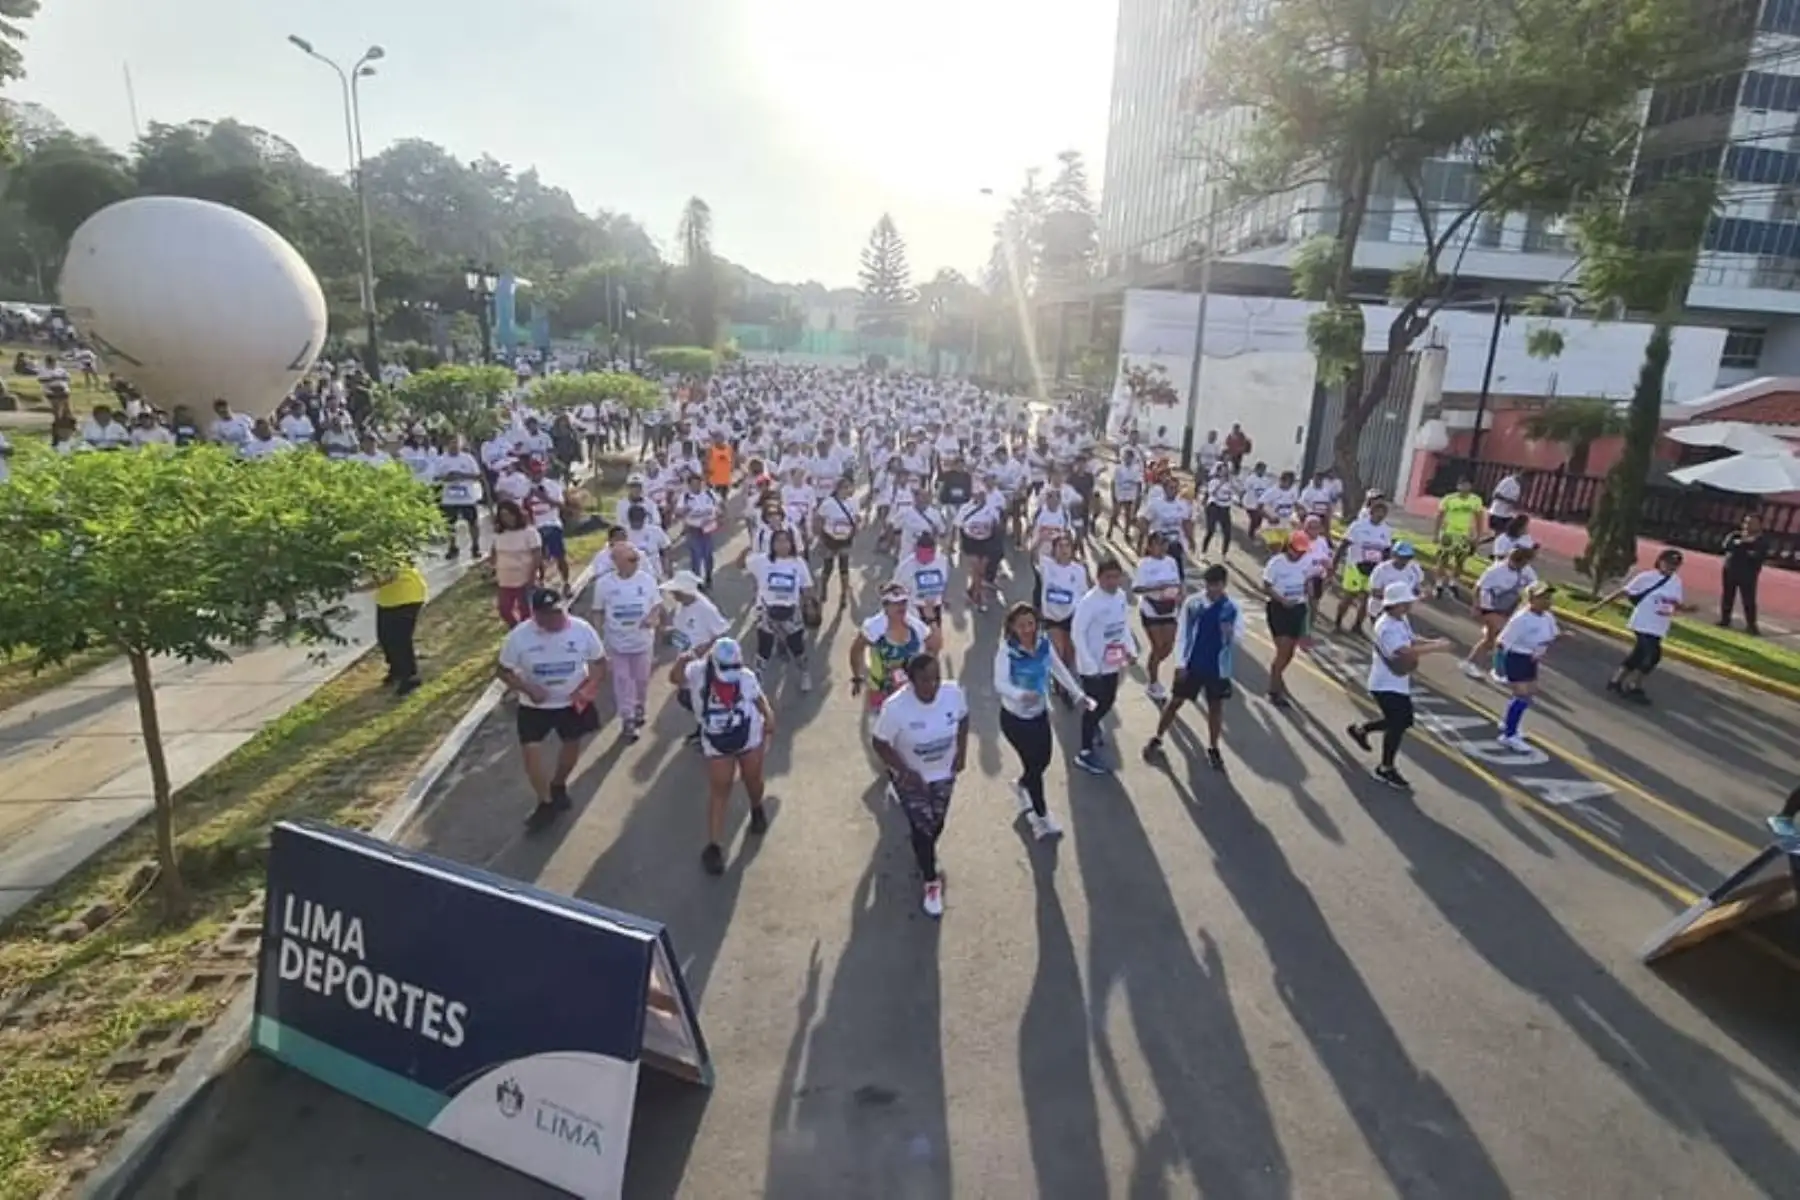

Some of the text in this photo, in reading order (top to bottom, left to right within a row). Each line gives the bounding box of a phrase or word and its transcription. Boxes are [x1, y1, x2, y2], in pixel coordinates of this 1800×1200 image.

[284, 894, 366, 960] LIMA
[279, 938, 469, 1048] DEPORTES
[535, 1107, 604, 1156] LIMA
